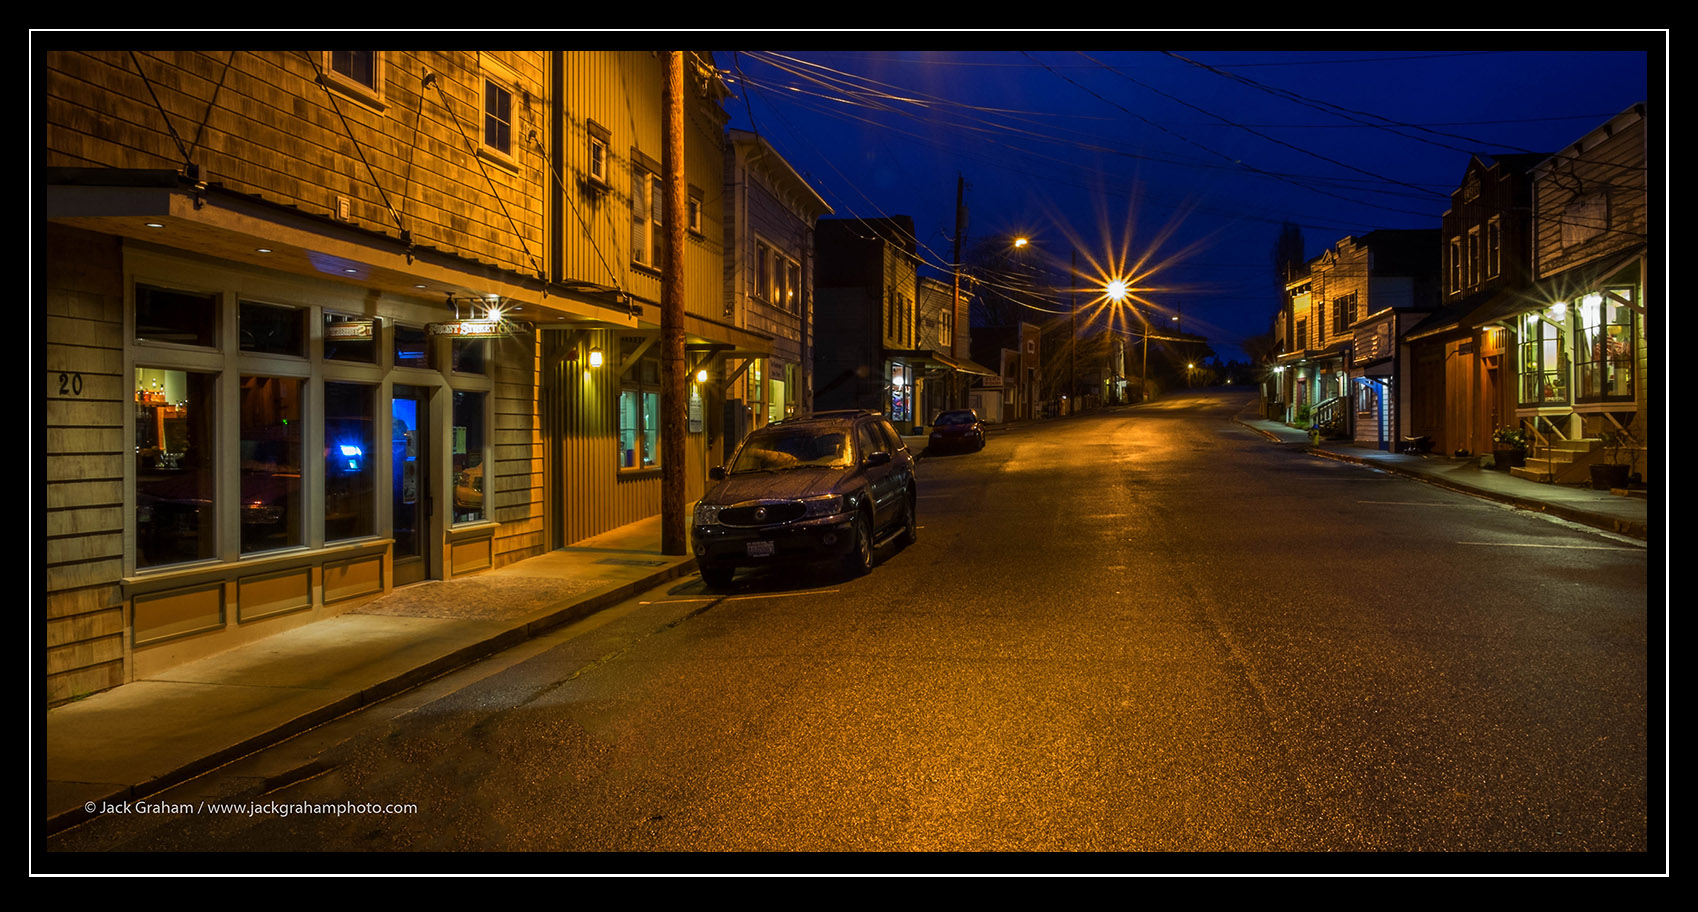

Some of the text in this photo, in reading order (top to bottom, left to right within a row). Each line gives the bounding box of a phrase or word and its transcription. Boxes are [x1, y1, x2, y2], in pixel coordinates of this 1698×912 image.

[428, 323, 460, 335] FRONT
[460, 322, 497, 336] STREET
[59, 373, 83, 396] 20
